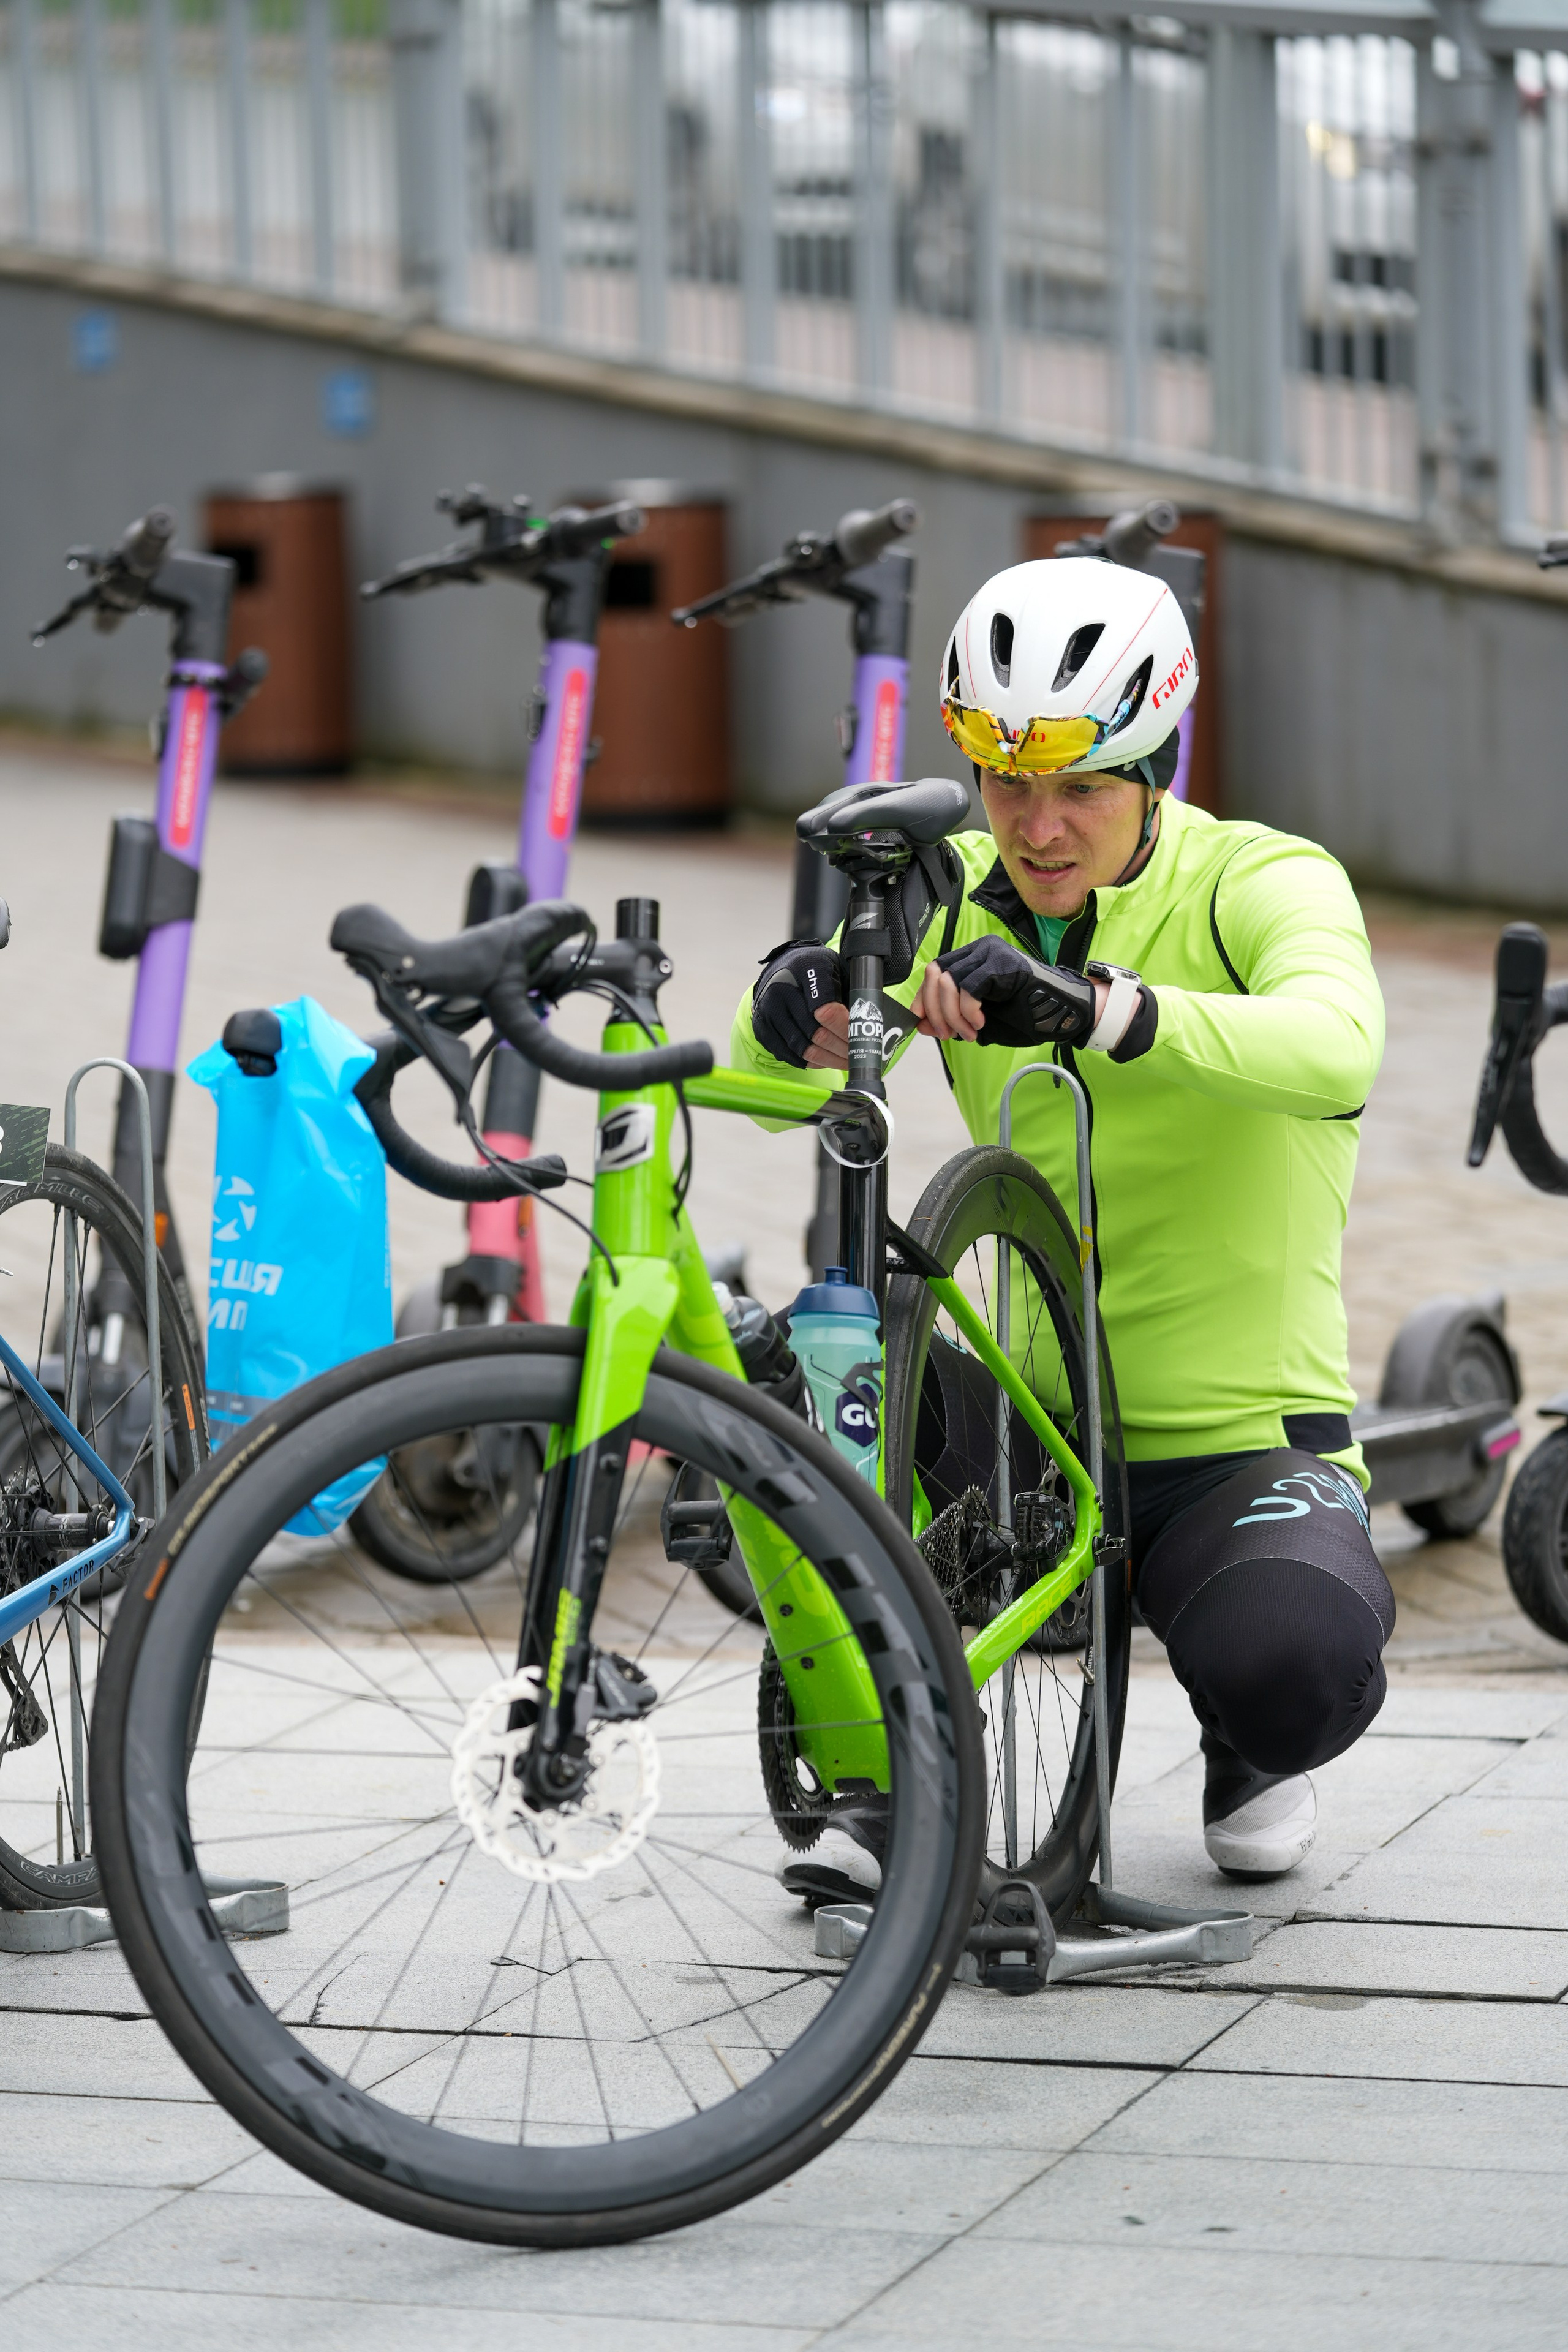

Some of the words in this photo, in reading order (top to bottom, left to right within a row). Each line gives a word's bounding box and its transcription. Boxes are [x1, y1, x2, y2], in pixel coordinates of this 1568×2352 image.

[1152, 647, 1193, 709] GIRO
[1008, 729, 1046, 743] IO
[1060, 1011, 1076, 1030] GEL
[62, 1560, 95, 1593] FACTOR
[1021, 1572, 1074, 1637] RACE
